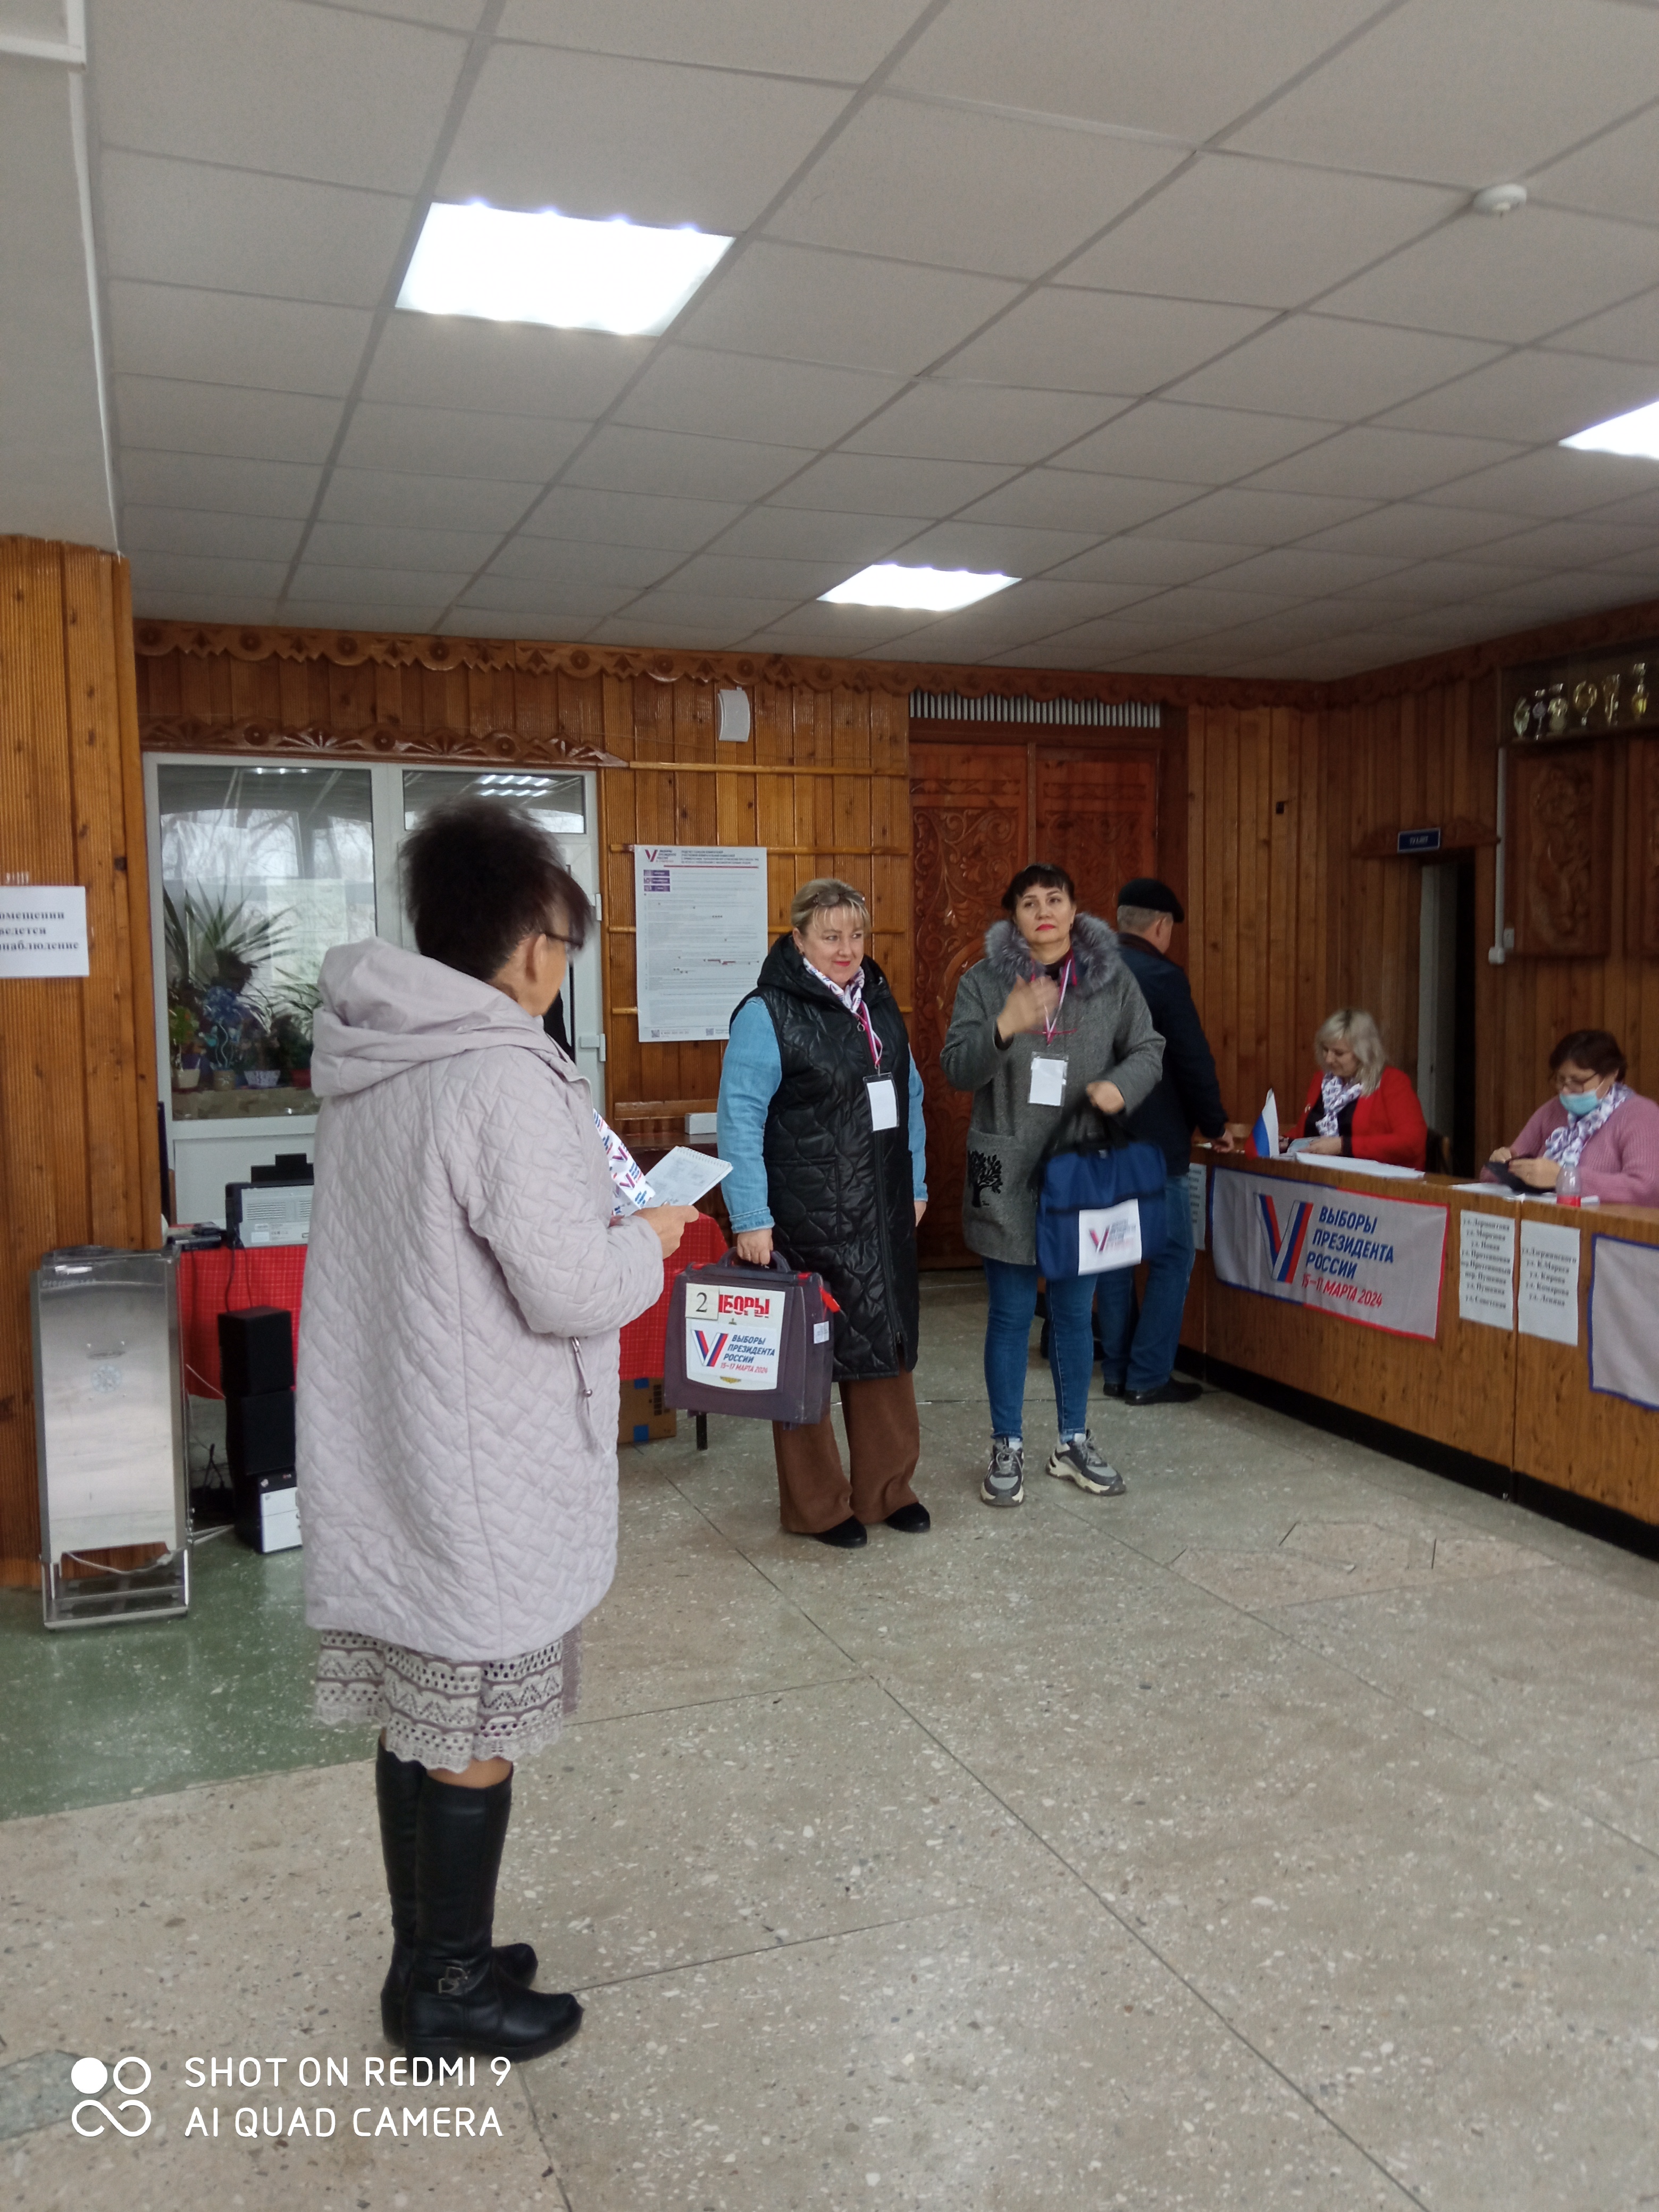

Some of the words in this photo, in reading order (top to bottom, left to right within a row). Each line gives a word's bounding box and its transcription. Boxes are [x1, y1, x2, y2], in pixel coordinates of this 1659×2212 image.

[0, 911, 64, 920] омещении
[1319, 1205, 1378, 1235] ВЫБОРЫ
[1312, 1228, 1394, 1264] ПРЕЗИДЕНТА
[1305, 1251, 1358, 1279] РОССИИ
[696, 1292, 708, 1312] 2
[1322, 1279, 1358, 1302] МАРТА
[1358, 1288, 1382, 1308] 2024
[719, 1294, 770, 1318] БОРЫ
[727, 1344, 775, 1356] ПРЕЗИДЕНТА
[732, 1335, 766, 1345] ВЫБОРЫ
[723, 1353, 755, 1363] РОССИИ
[735, 1363, 753, 1372] МАРТА
